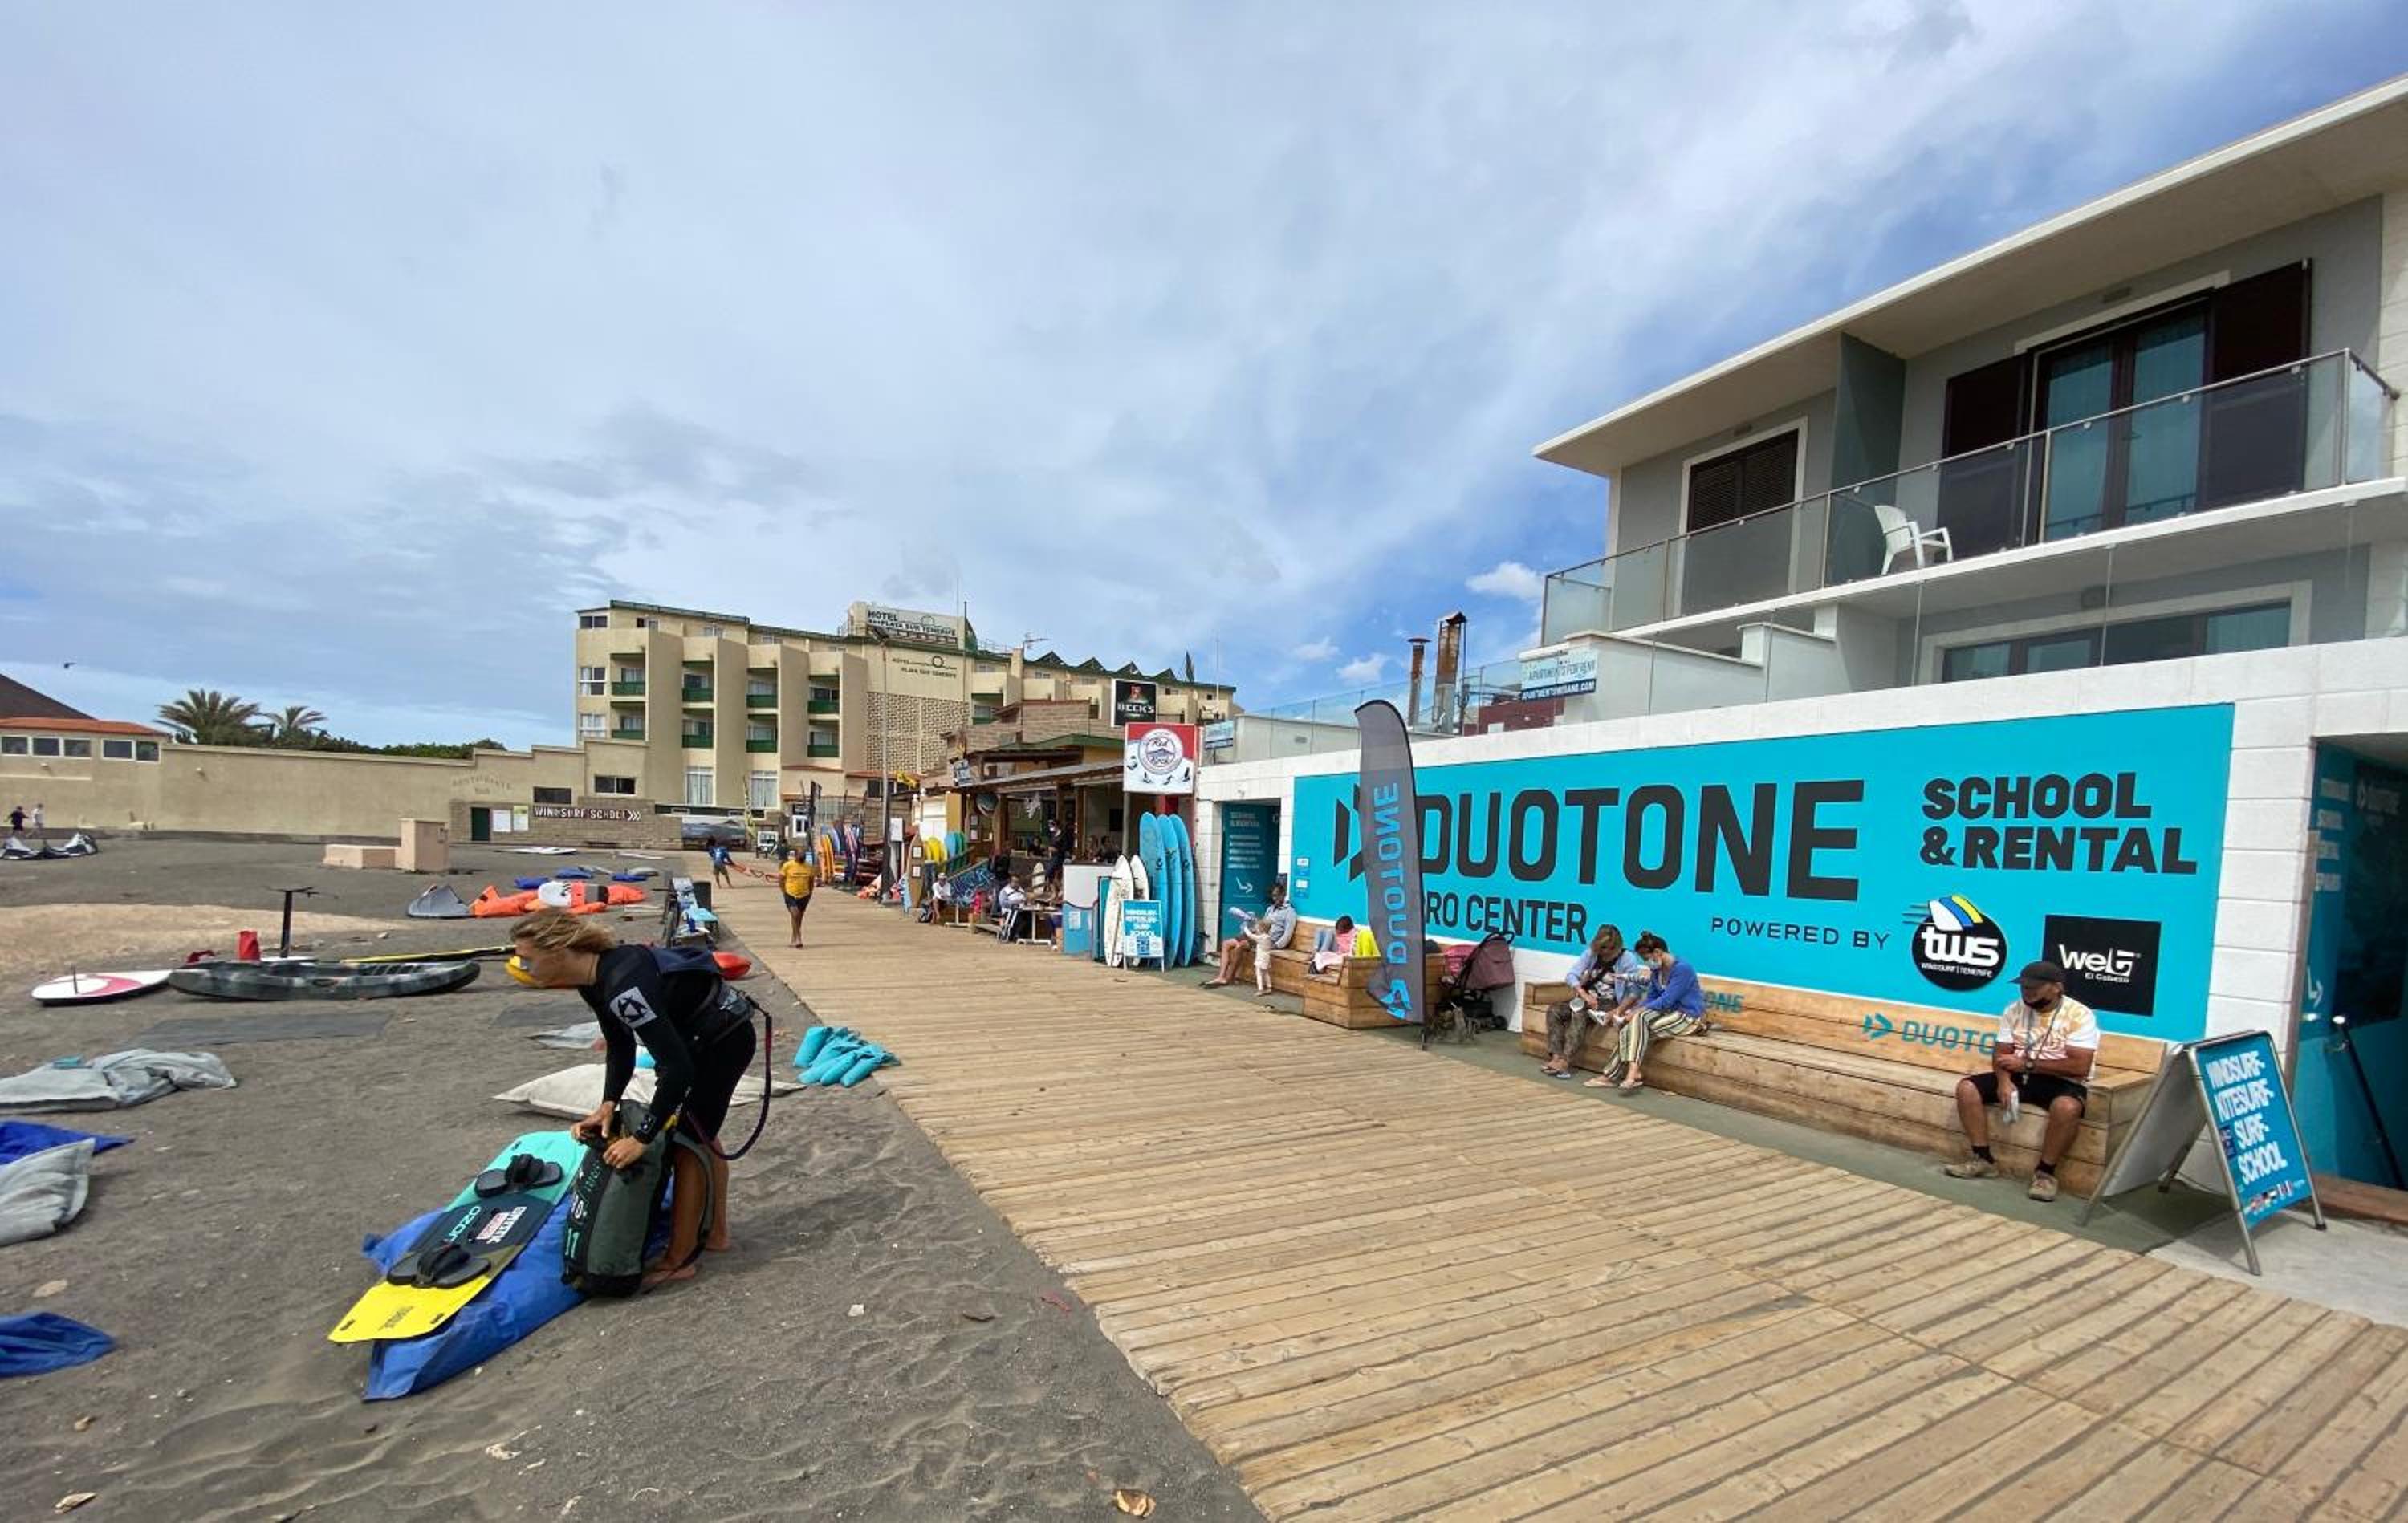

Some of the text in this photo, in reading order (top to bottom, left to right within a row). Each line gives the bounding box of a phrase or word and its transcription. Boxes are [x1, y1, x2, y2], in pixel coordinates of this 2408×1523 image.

[868, 610, 898, 622] HOTEL
[1921, 772, 2151, 821] SCHOOL
[1416, 780, 1865, 901] DUOTONE
[1424, 891, 1588, 945] RO CENTER
[1711, 916, 1891, 950] POWERED BY
[1921, 926, 1999, 968] tws
[2237, 1141, 2288, 1185] SCHOOL
